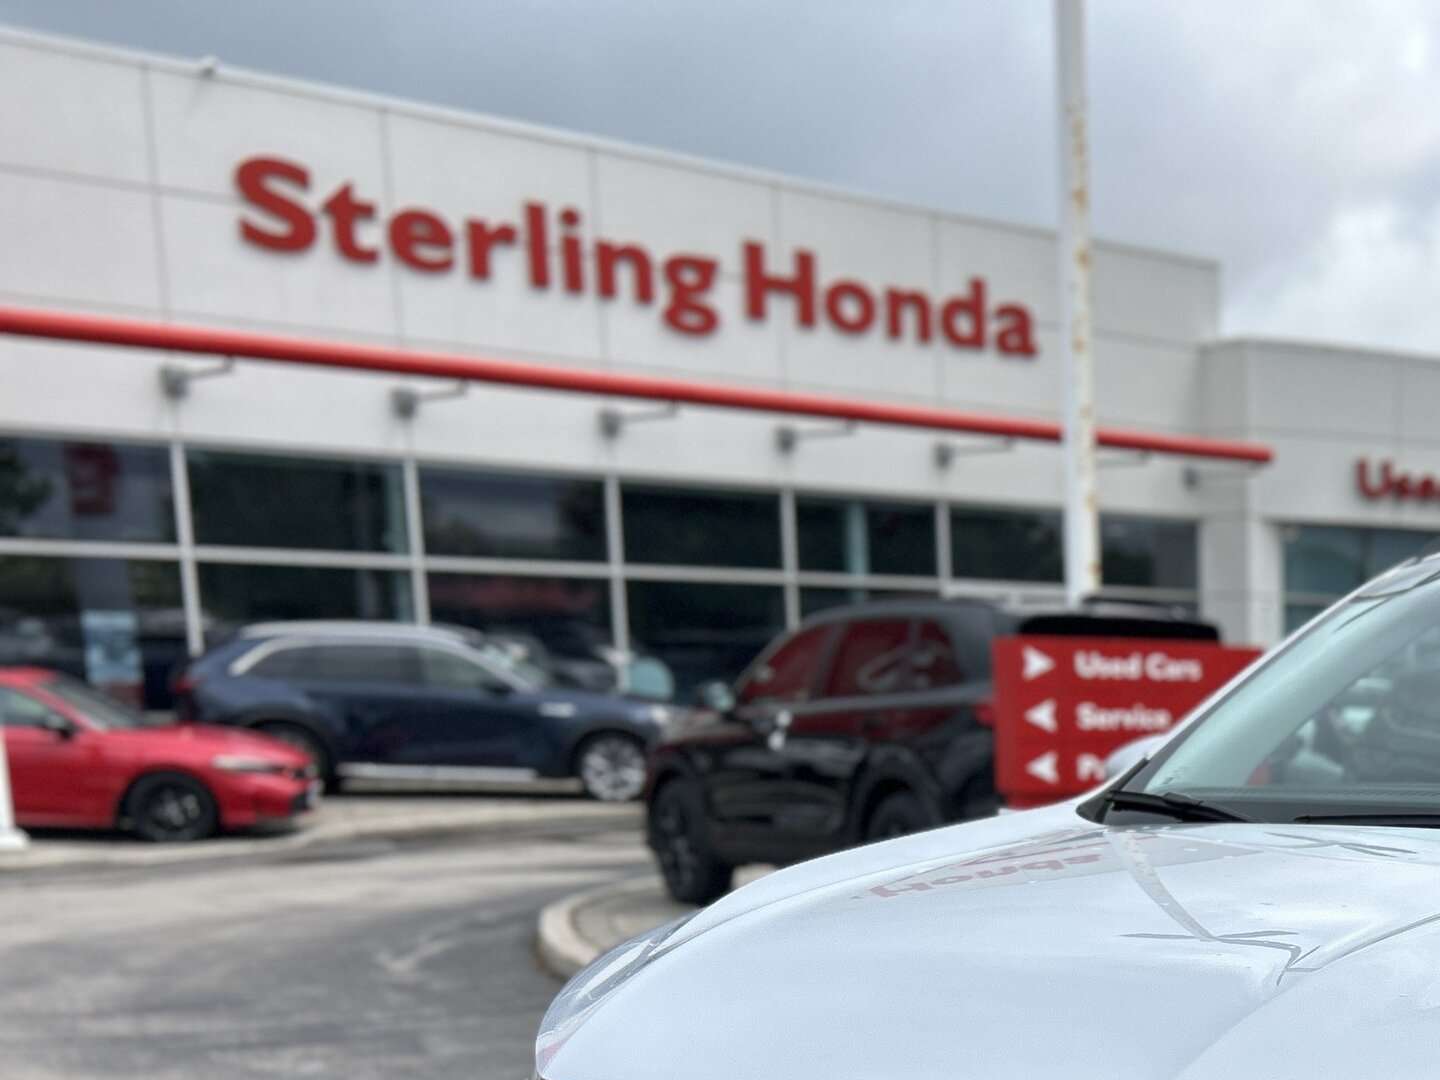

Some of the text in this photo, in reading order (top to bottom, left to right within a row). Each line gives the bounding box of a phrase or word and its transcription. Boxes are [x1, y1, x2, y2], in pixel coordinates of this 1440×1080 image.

[233, 156, 1037, 357] Sterling Honda
[1074, 652, 1203, 681] Used Cars
[1075, 702, 1172, 730] Service
